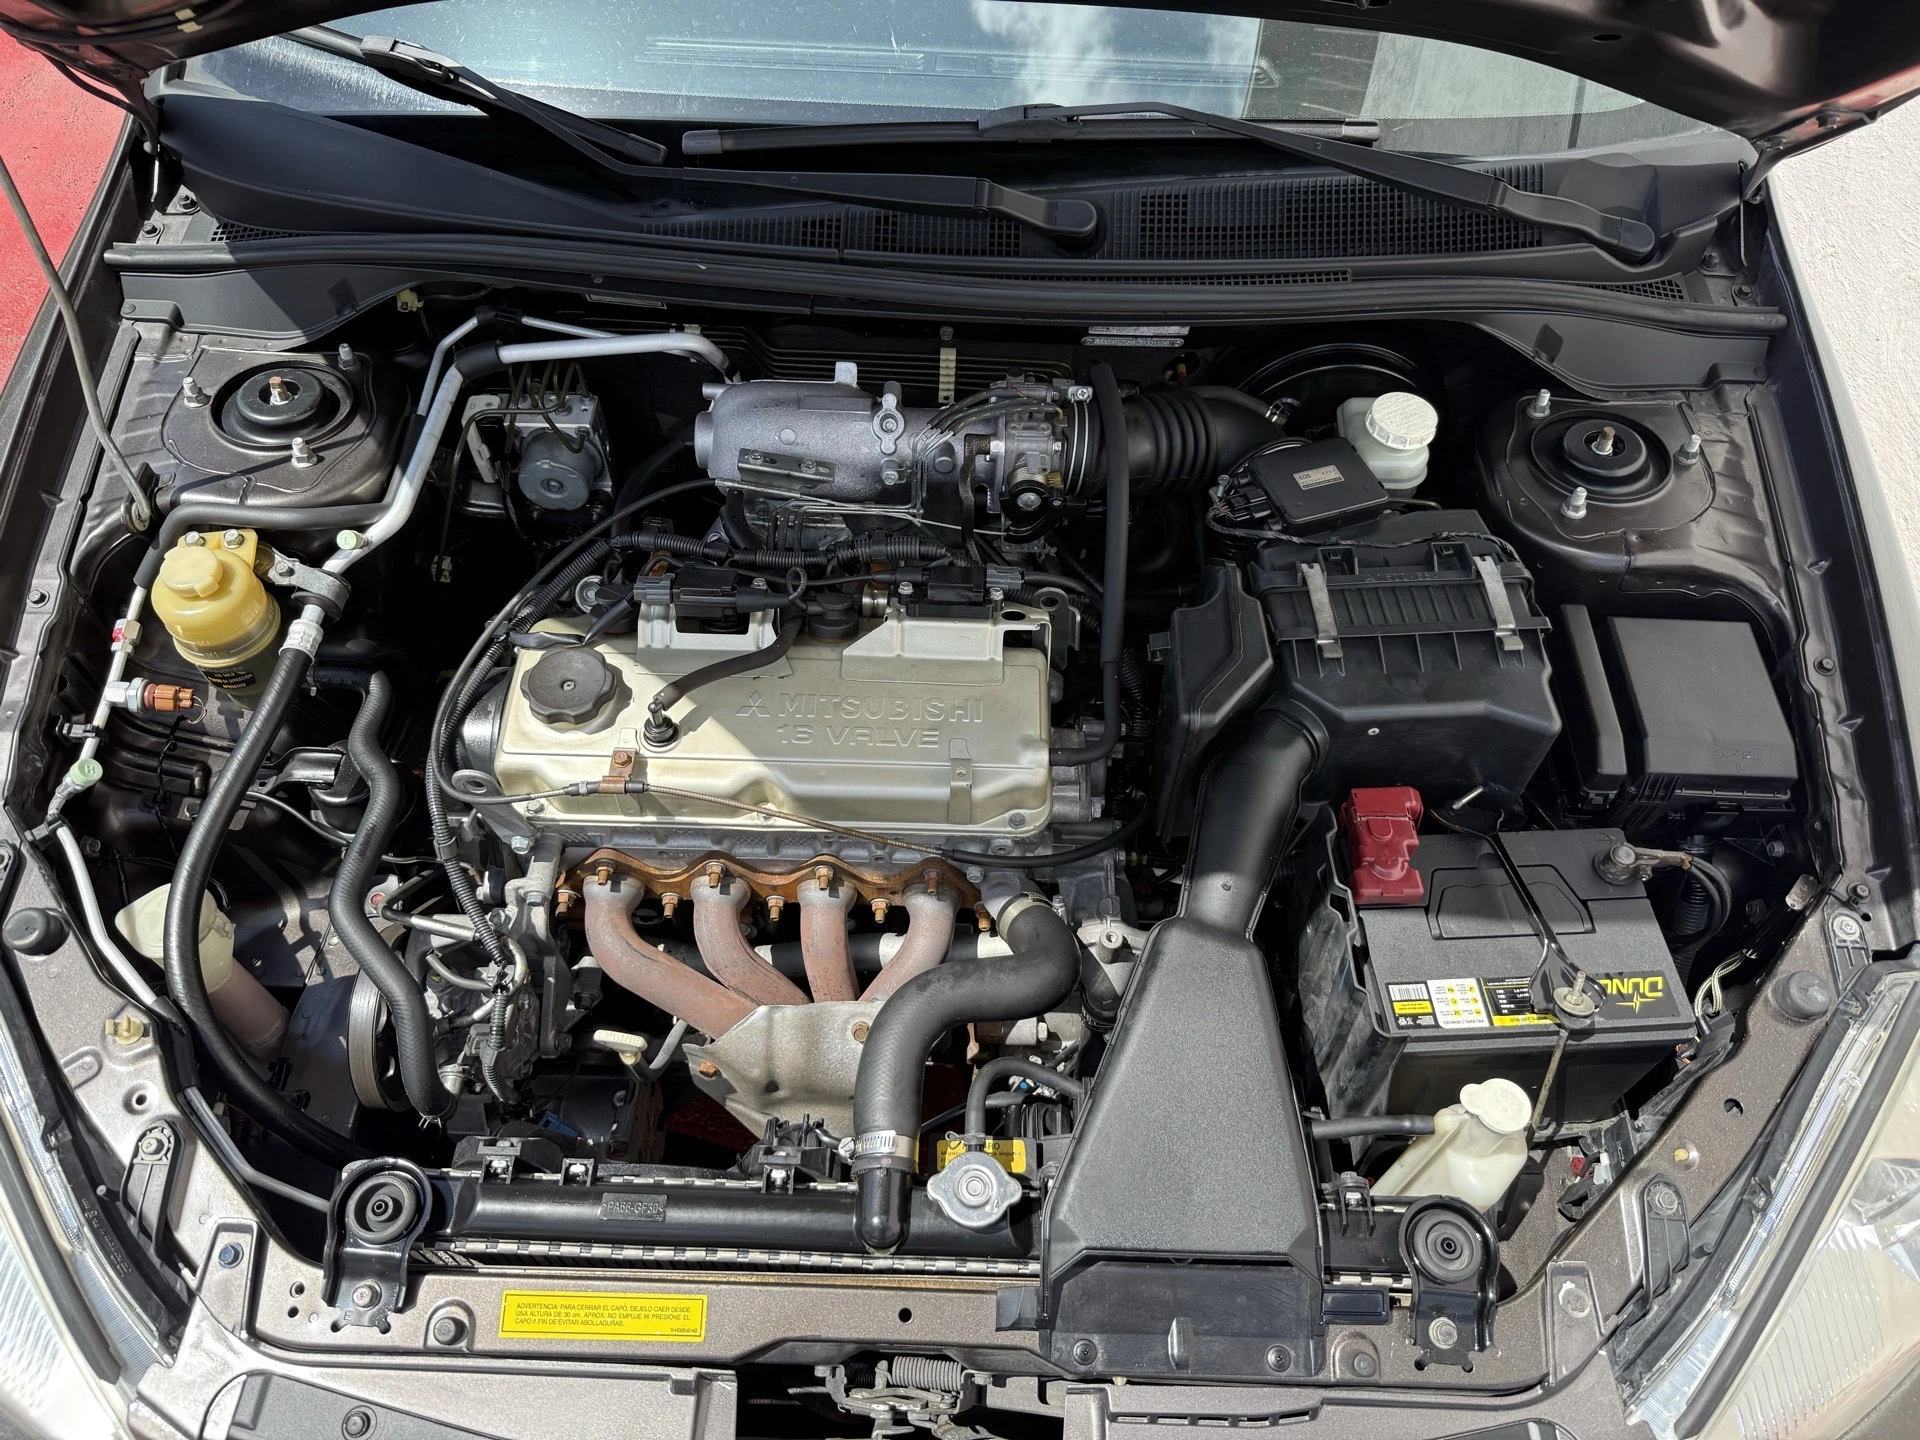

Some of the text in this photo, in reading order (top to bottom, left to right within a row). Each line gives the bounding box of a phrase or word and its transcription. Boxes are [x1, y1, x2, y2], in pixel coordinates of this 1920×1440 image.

[778, 692, 983, 722] MITSUBISHI
[777, 724, 940, 748] 16 VALVE
[85, 764, 95, 774] H
[1599, 976, 1663, 998] DUNC
[560, 1303, 576, 1311] PARA
